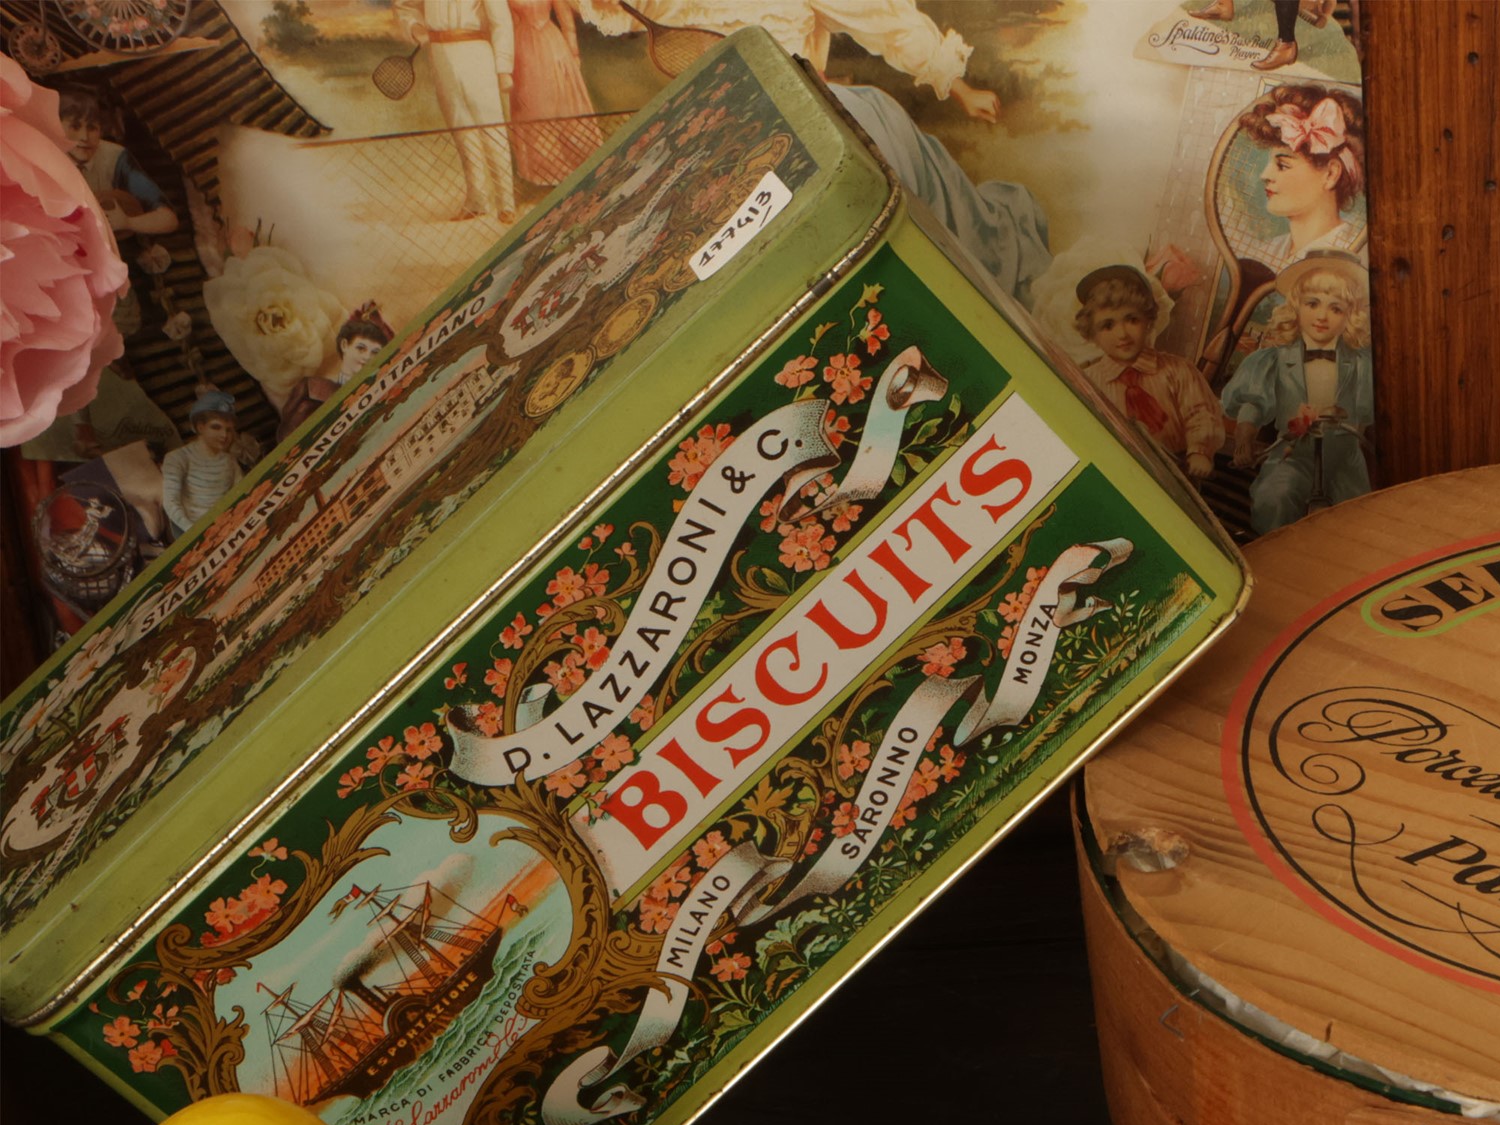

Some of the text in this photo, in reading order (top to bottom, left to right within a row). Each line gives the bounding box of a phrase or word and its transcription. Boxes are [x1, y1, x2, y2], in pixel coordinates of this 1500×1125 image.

[1251, 35, 1273, 49] Ball
[698, 190, 773, 267] 177413
[140, 296, 486, 633] STABILIMENTO ANGLO-ITALIANO
[504, 427, 804, 775] D. LAZZARONI & C.
[602, 434, 1033, 852] BISCUITS
[667, 602, 1059, 968] MILANO SARONNO MONZA
[353, 950, 535, 1125] MARCA DI FABBRICA DEPOSITATA
[367, 971, 478, 1076] ESPORTAZIONE
